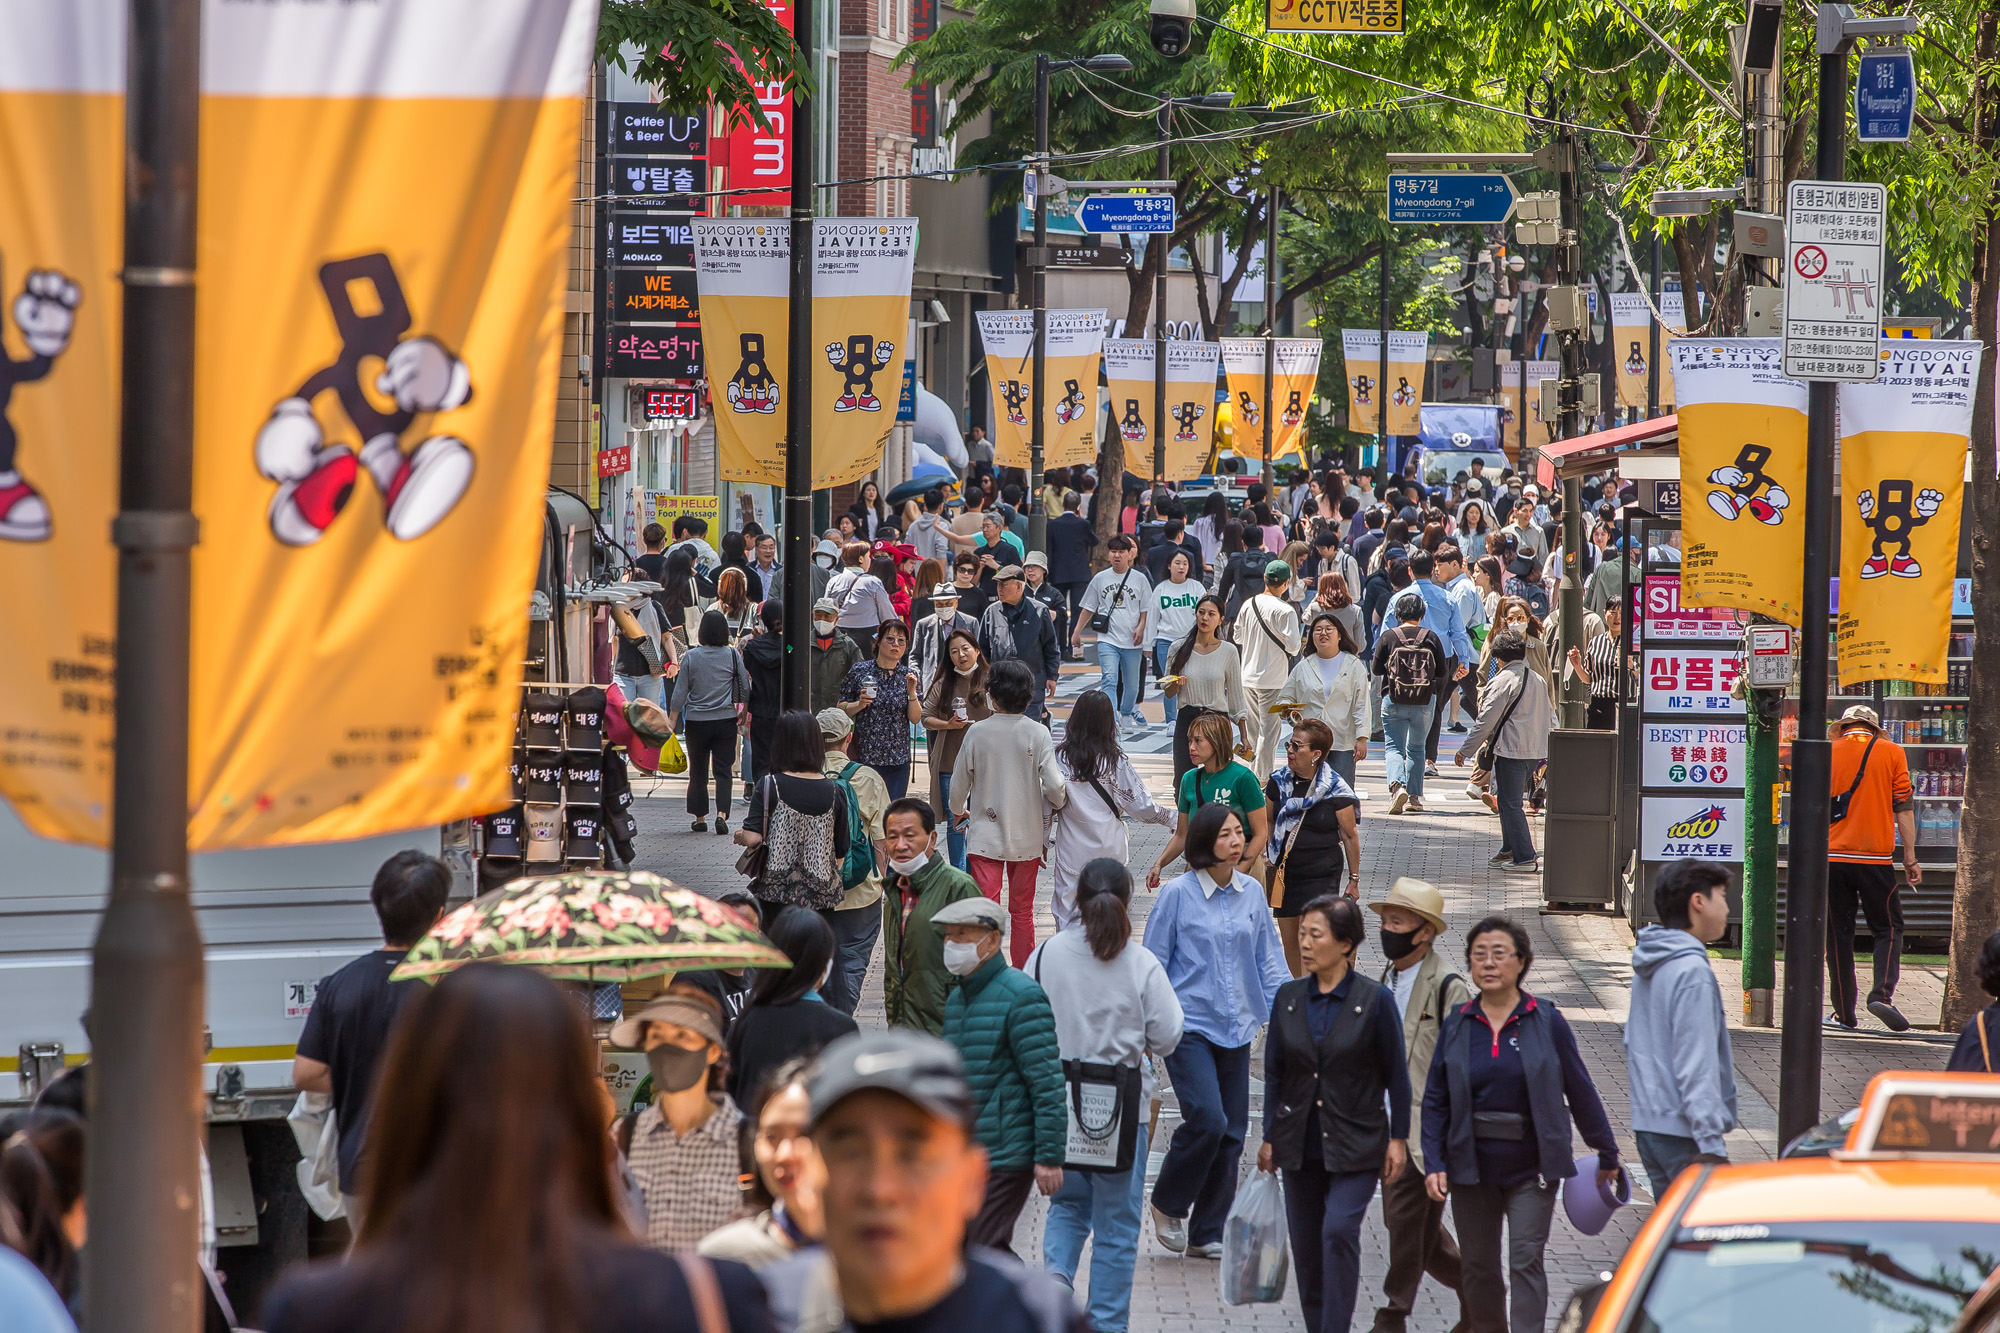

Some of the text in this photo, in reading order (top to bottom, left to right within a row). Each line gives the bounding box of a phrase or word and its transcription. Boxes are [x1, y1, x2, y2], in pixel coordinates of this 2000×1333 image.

[624, 116, 664, 127] Coffee
[624, 130, 664, 140] & Beer
[689, 142, 700, 150] 9F
[627, 167, 694, 192] 방탈출
[1395, 179, 1438, 194] 명동7길
[688, 198, 700, 207] 8F
[1395, 198, 1474, 208] Myeongdong 7-gil
[1796, 189, 1879, 210] 통행금지(제한)알림
[1134, 200, 1171, 211] 명동8길
[1102, 214, 1151, 222] Myeongdong
[645, 276, 671, 291] WE
[626, 295, 690, 309] 시계거래소
[688, 310, 699, 318] 6F
[1860, 327, 1874, 337] 일대
[618, 334, 700, 360] 약손명가
[687, 366, 698, 374] 5F
[1797, 362, 1865, 373] 남대문경찰서장
[1914, 378, 1933, 386] 명동
[1934, 378, 1969, 388] 페스티벌
[681, 499, 717, 508] HELLO
[682, 510, 717, 519] Massage
[1160, 593, 1198, 610] Daily
[1650, 657, 1746, 691] 상품권
[1669, 696, 1692, 707] 사고
[1706, 696, 1730, 708] 팔고
[531, 712, 559, 724] 연예인
[576, 713, 598, 726] 대장
[1650, 729, 1746, 744] BEST PRICE
[1667, 817, 1719, 839] toto
[1661, 843, 1733, 857] 스포츠토토
